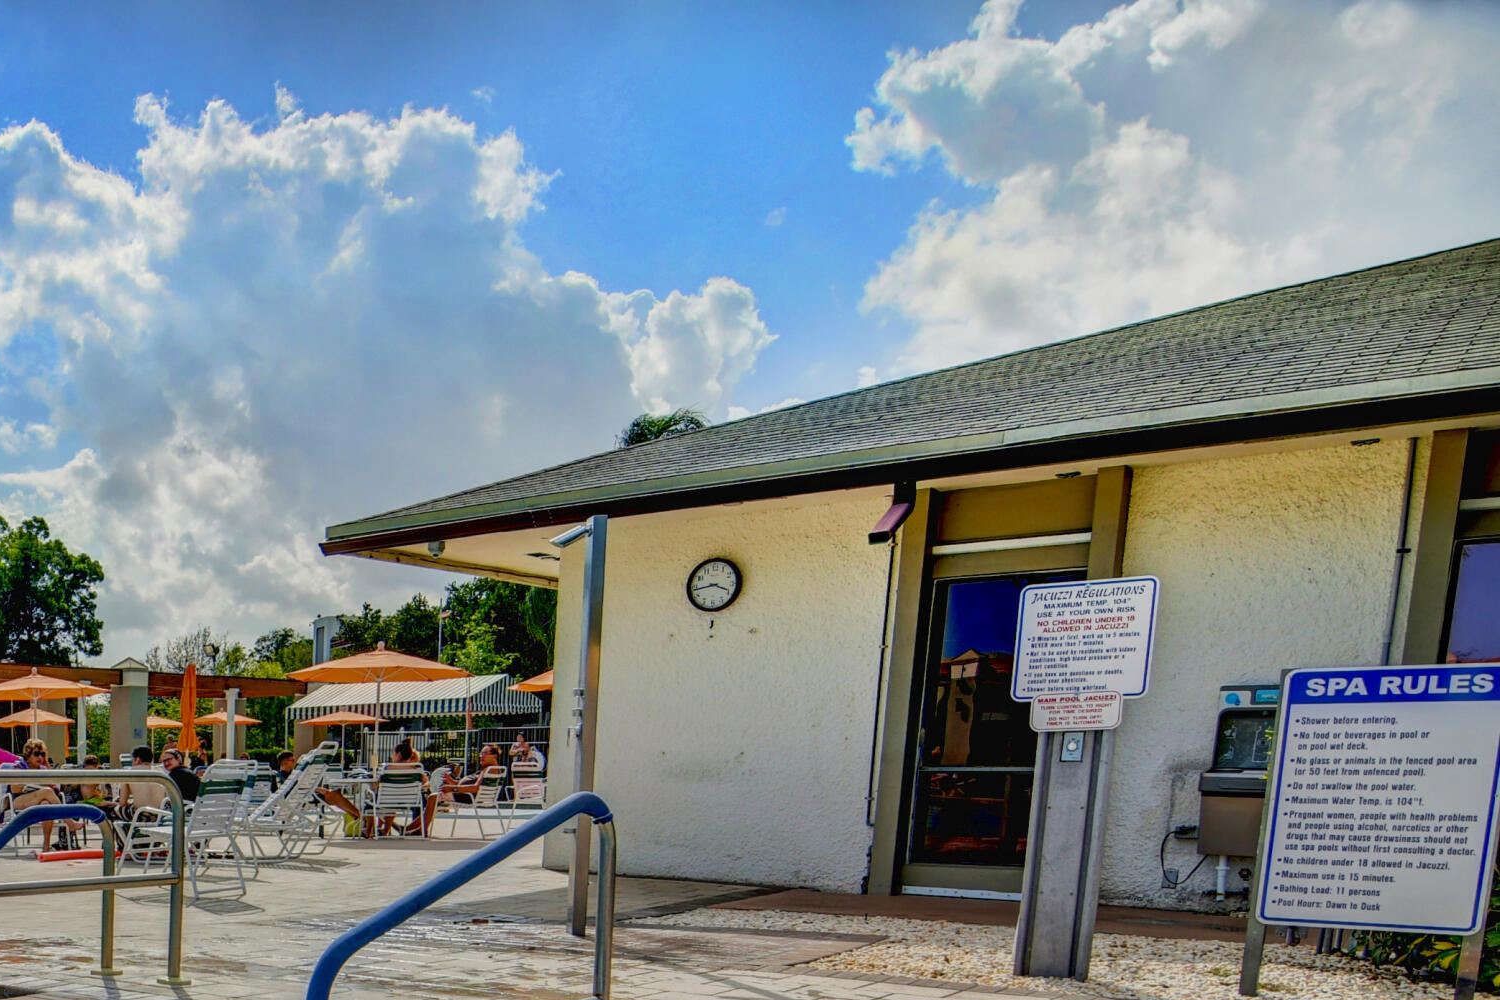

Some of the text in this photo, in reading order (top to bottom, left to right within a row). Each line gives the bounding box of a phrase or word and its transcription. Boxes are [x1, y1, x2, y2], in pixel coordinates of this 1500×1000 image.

[1031, 585, 1146, 605] JACUZZI REGULATIONS
[1044, 600, 1083, 610] MAXIMUM
[1052, 618, 1092, 626] CHILDREN
[1095, 616, 1123, 624] UNDER
[1043, 625, 1081, 633] ALLOWED
[1305, 673, 1494, 697] SPA RULES
[1300, 716, 1330, 725] Shower
[1333, 715, 1359, 725] before
[1298, 731, 1310, 740] No
[1312, 731, 1330, 740] food
[1344, 730, 1386, 740] beverages
[1388, 730, 1397, 739] in
[1399, 730, 1418, 740] pool
[1420, 731, 1430, 739] or
[1309, 741, 1327, 752] pool
[1329, 741, 1344, 750] wet
[1295, 756, 1307, 765] No
[1309, 756, 1330, 766] glass
[1344, 756, 1376, 765] animals
[1378, 756, 1387, 765] in
[1389, 756, 1403, 765] the
[1405, 756, 1434, 765] fenced
[1436, 756, 1455, 766] pool
[1308, 767, 1321, 776] 50
[1323, 767, 1339, 776] feet
[1340, 767, 1360, 776] from
[1362, 767, 1400, 776] unfenced
[1292, 781, 1303, 790] Do
[1305, 782, 1319, 790] not
[1320, 782, 1353, 790] swallow
[1355, 782, 1368, 791] the
[1370, 782, 1388, 792] pool
[1290, 795, 1329, 805] Maximum
[1331, 796, 1355, 805] Water
[1384, 797, 1393, 806] is
[1288, 809, 1324, 820] Pregnant
[1359, 811, 1387, 821] people
[1389, 812, 1407, 821] with
[1409, 812, 1436, 821] health
[1438, 812, 1478, 823] problems
[1287, 821, 1302, 829] and
[1304, 821, 1330, 831] people
[1332, 822, 1355, 832] using
[1391, 823, 1431, 832] narcotics
[1433, 825, 1443, 833] or
[1445, 824, 1469, 833] other
[1285, 832, 1308, 842] drugs
[1310, 832, 1326, 840] that
[1328, 834, 1345, 844] may
[1374, 834, 1421, 843] drowsiness
[1423, 835, 1451, 844] should
[1453, 836, 1468, 845] not
[1300, 844, 1315, 853] spa
[1317, 843, 1339, 852] pools
[1341, 843, 1371, 853] without
[1372, 844, 1391, 853] first
[1393, 845, 1436, 856] consulting
[1282, 856, 1294, 865] No
[1296, 856, 1328, 866] children
[1331, 858, 1354, 867] under
[1358, 858, 1368, 867] 18
[1370, 859, 1402, 868] allowed
[1404, 860, 1413, 869] in
[1280, 870, 1319, 879] Maximum
[1337, 872, 1345, 881] is
[1349, 872, 1359, 881] 15
[1279, 884, 1308, 895] Bathing
[1336, 886, 1345, 895] 11
[1348, 888, 1380, 897] persons
[1276, 898, 1295, 907] Pool
[1325, 900, 1347, 909] Dawn
[1349, 901, 1358, 910] to
[1360, 902, 1380, 911] Dusk
